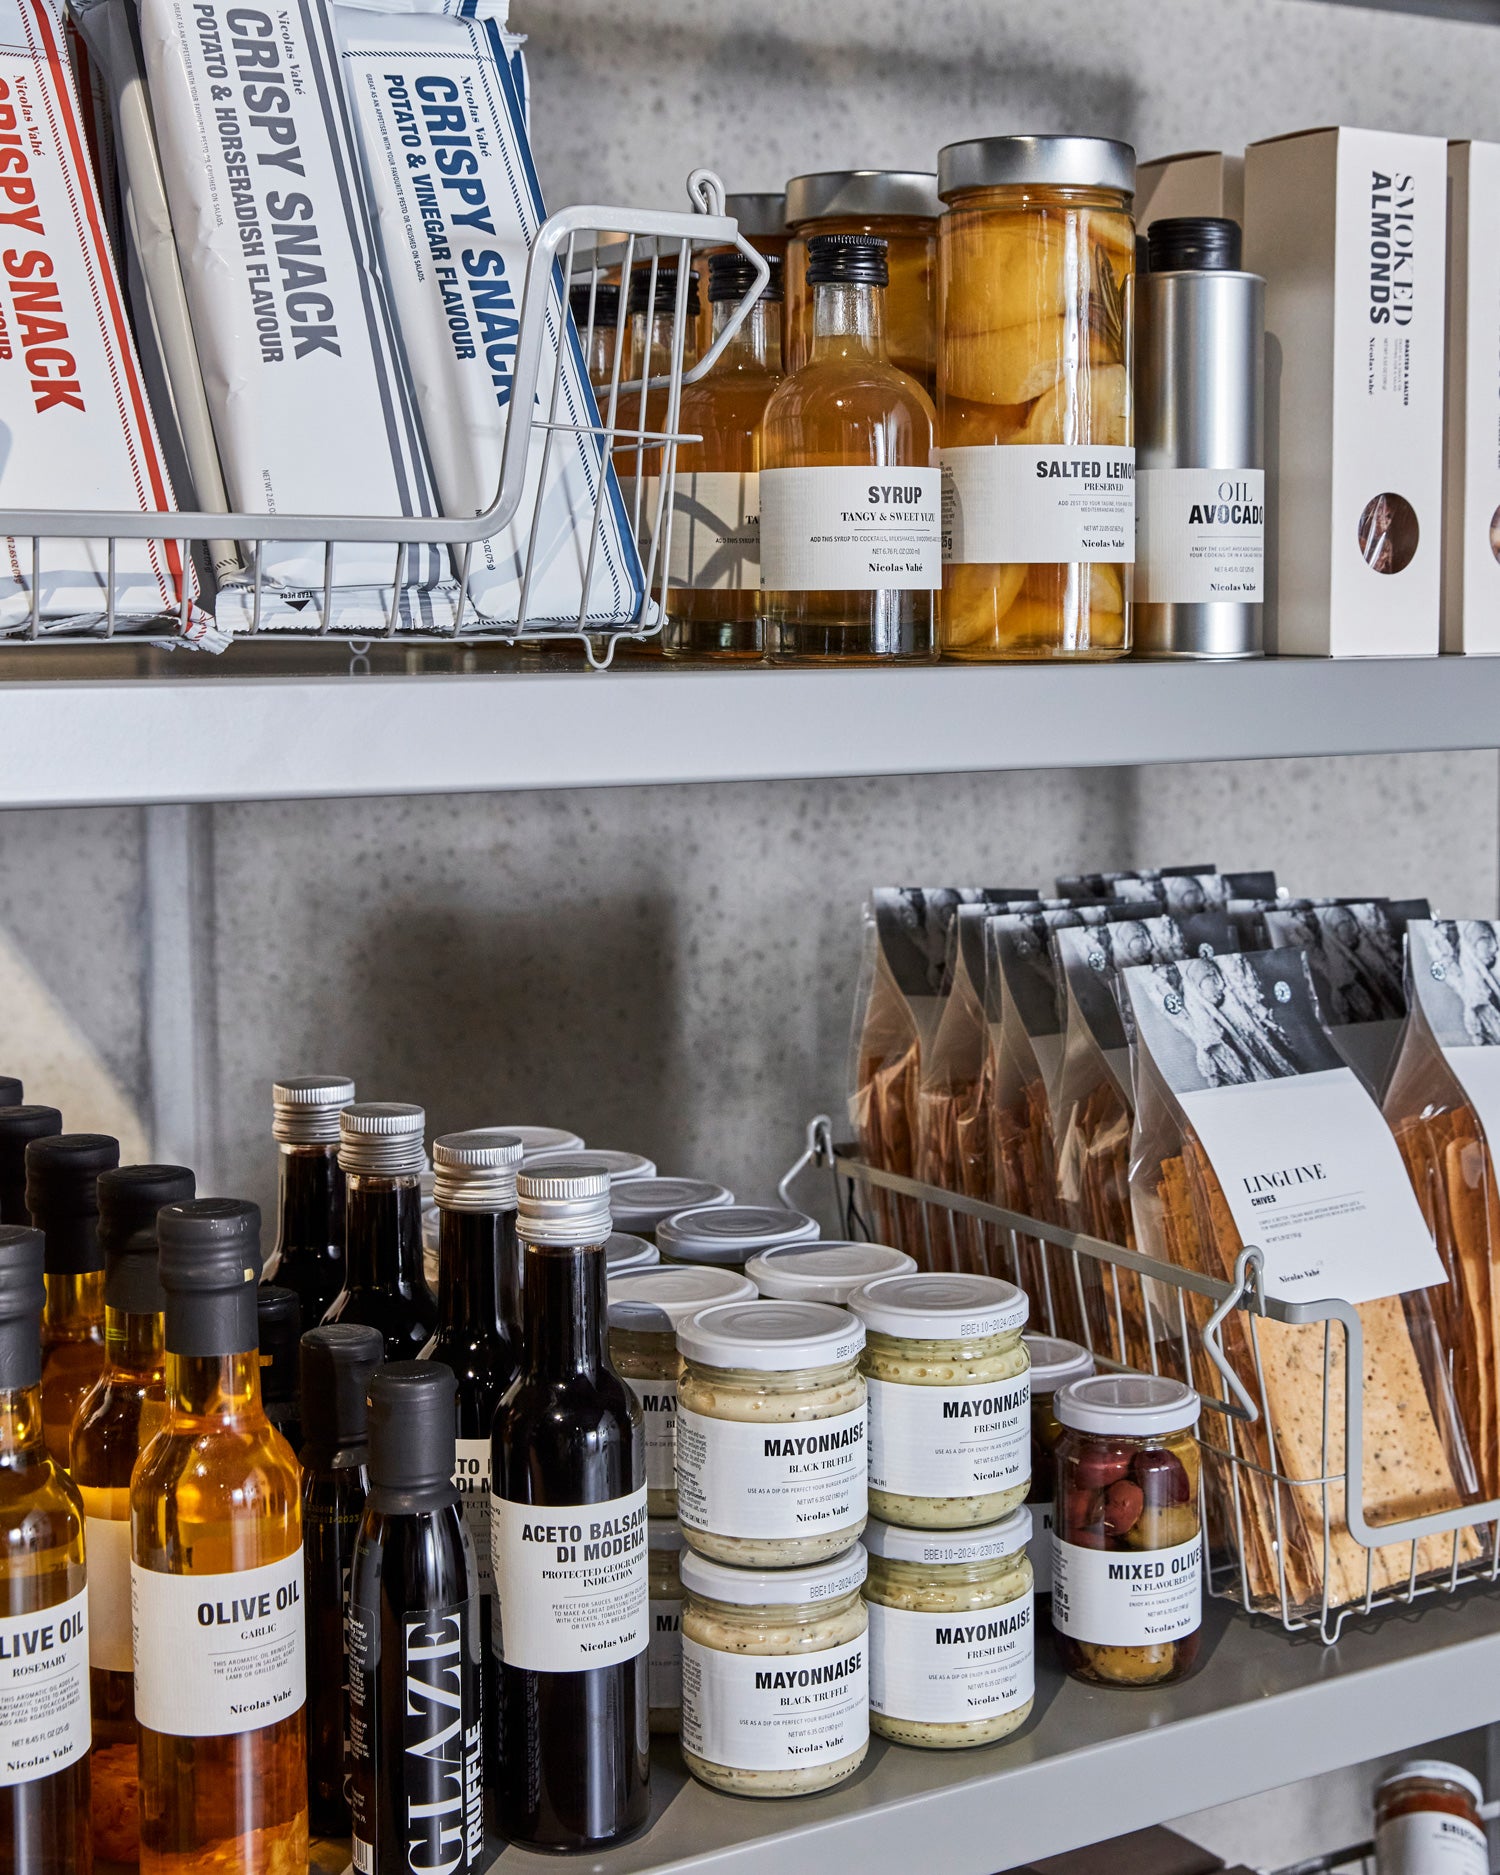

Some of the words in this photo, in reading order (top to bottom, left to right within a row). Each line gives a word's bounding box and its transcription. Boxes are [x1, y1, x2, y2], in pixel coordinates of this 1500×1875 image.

[193, 4, 228, 78] POTATO
[277, 10, 295, 59] Nicolas
[289, 64, 306, 95] Vahé
[211, 85, 232, 101] &
[12, 75, 33, 122] Nicolas
[28, 126, 45, 156] Vahé
[384, 74, 422, 148] POTATO
[461, 75, 479, 124] Nicolas
[475, 127, 492, 157] Vahé
[0, 78, 45, 236] SPY
[406, 154, 427, 169] &
[415, 76, 496, 236] CRISPY
[215, 108, 265, 257] HORSERADISH
[226, 8, 306, 177] CRISPY
[266, 191, 342, 360] SNACK
[412, 173, 451, 261] VINEGAR
[1370, 171, 1391, 324] ALMONDS
[1394, 173, 1415, 326] SMOKED
[246, 264, 284, 363] FLAVOUR
[436, 267, 476, 360] FLAVOUR
[3, 249, 86, 413] SNACK
[1037, 461, 1100, 478] SALTED
[868, 486, 922, 504] SYRUP
[1085, 483, 1123, 491] PRESERVED
[1218, 482, 1252, 502] OIL
[841, 512, 877, 522] TANGY
[879, 513, 887, 521] &
[890, 512, 919, 522] SWEET
[1189, 505, 1263, 524] AVOCADO
[869, 563, 903, 572] Nicolas
[906, 563, 922, 572] Vahé
[1243, 1164, 1326, 1193] LINGUINE
[1252, 1195, 1276, 1206] CHIVES
[1279, 1274, 1303, 1282] Nicolas
[943, 1384, 1029, 1418] MAYONNAISE
[974, 1422, 1000, 1434] FRESH
[765, 1421, 863, 1456] MAYONNAISE
[790, 1462, 819, 1473] BLACK
[821, 1453, 853, 1469] TRUFFLE
[973, 1470, 1003, 1481] Nicolas
[1005, 1463, 1019, 1474] Vahé
[826, 1480, 841, 1488] BURGER
[796, 1512, 830, 1522] Nicolas
[832, 1504, 849, 1515] Vahé
[522, 1524, 582, 1543] ACETO
[557, 1546, 575, 1563] DI
[584, 1527, 644, 1561] MODENA
[543, 1568, 601, 1579] PROTECTED
[584, 1568, 633, 1587] INDICATION
[1108, 1563, 1164, 1580] MIXED
[1132, 1584, 1141, 1592] IN
[1144, 1574, 1188, 1592] FLAVOURED
[198, 1593, 270, 1626] OLIVE
[276, 1580, 299, 1611] OIL
[607, 1601, 629, 1610] DRESSING
[573, 1613, 599, 1622] CHICKEN,
[601, 1609, 621, 1618] TOMATO
[611, 1615, 626, 1623] BREAD
[60, 1611, 83, 1643] OIL
[241, 1624, 276, 1640] GARLIC
[936, 1607, 1030, 1644] MAYONNAISE
[1145, 1624, 1175, 1634] Nicolas
[1177, 1617, 1191, 1628] Vahé
[580, 1639, 617, 1652] Nicolas
[619, 1630, 636, 1644] Vahé
[968, 1647, 995, 1659] FRESH
[998, 1641, 1016, 1654] BASIL
[13, 1653, 66, 1677] ROSEMARY
[227, 1664, 252, 1673] FLAVOUR
[228, 1656, 258, 1665] AROMATIC
[254, 1666, 275, 1676] GRILLED
[756, 1652, 861, 1689] MAYONNAISE
[17, 1688, 47, 1701] AROMATIC
[230, 1700, 270, 1714] Nicolas
[273, 1688, 292, 1703] Vahé
[781, 1696, 811, 1706] BLACK
[813, 1684, 848, 1701] TRUFFLE
[968, 1696, 999, 1706] Nicolas
[1002, 1688, 1017, 1698] Vahé
[30, 1710, 55, 1720] ROASTED
[818, 1712, 835, 1720] BURGER
[405, 1613, 463, 1875] GLAZE
[788, 1744, 823, 1754] Nicolas
[826, 1735, 844, 1747] Vahé
[7, 1753, 49, 1771] Nicolas
[53, 1742, 73, 1759] Vahé
[466, 1720, 481, 1867] TRUFFLE
